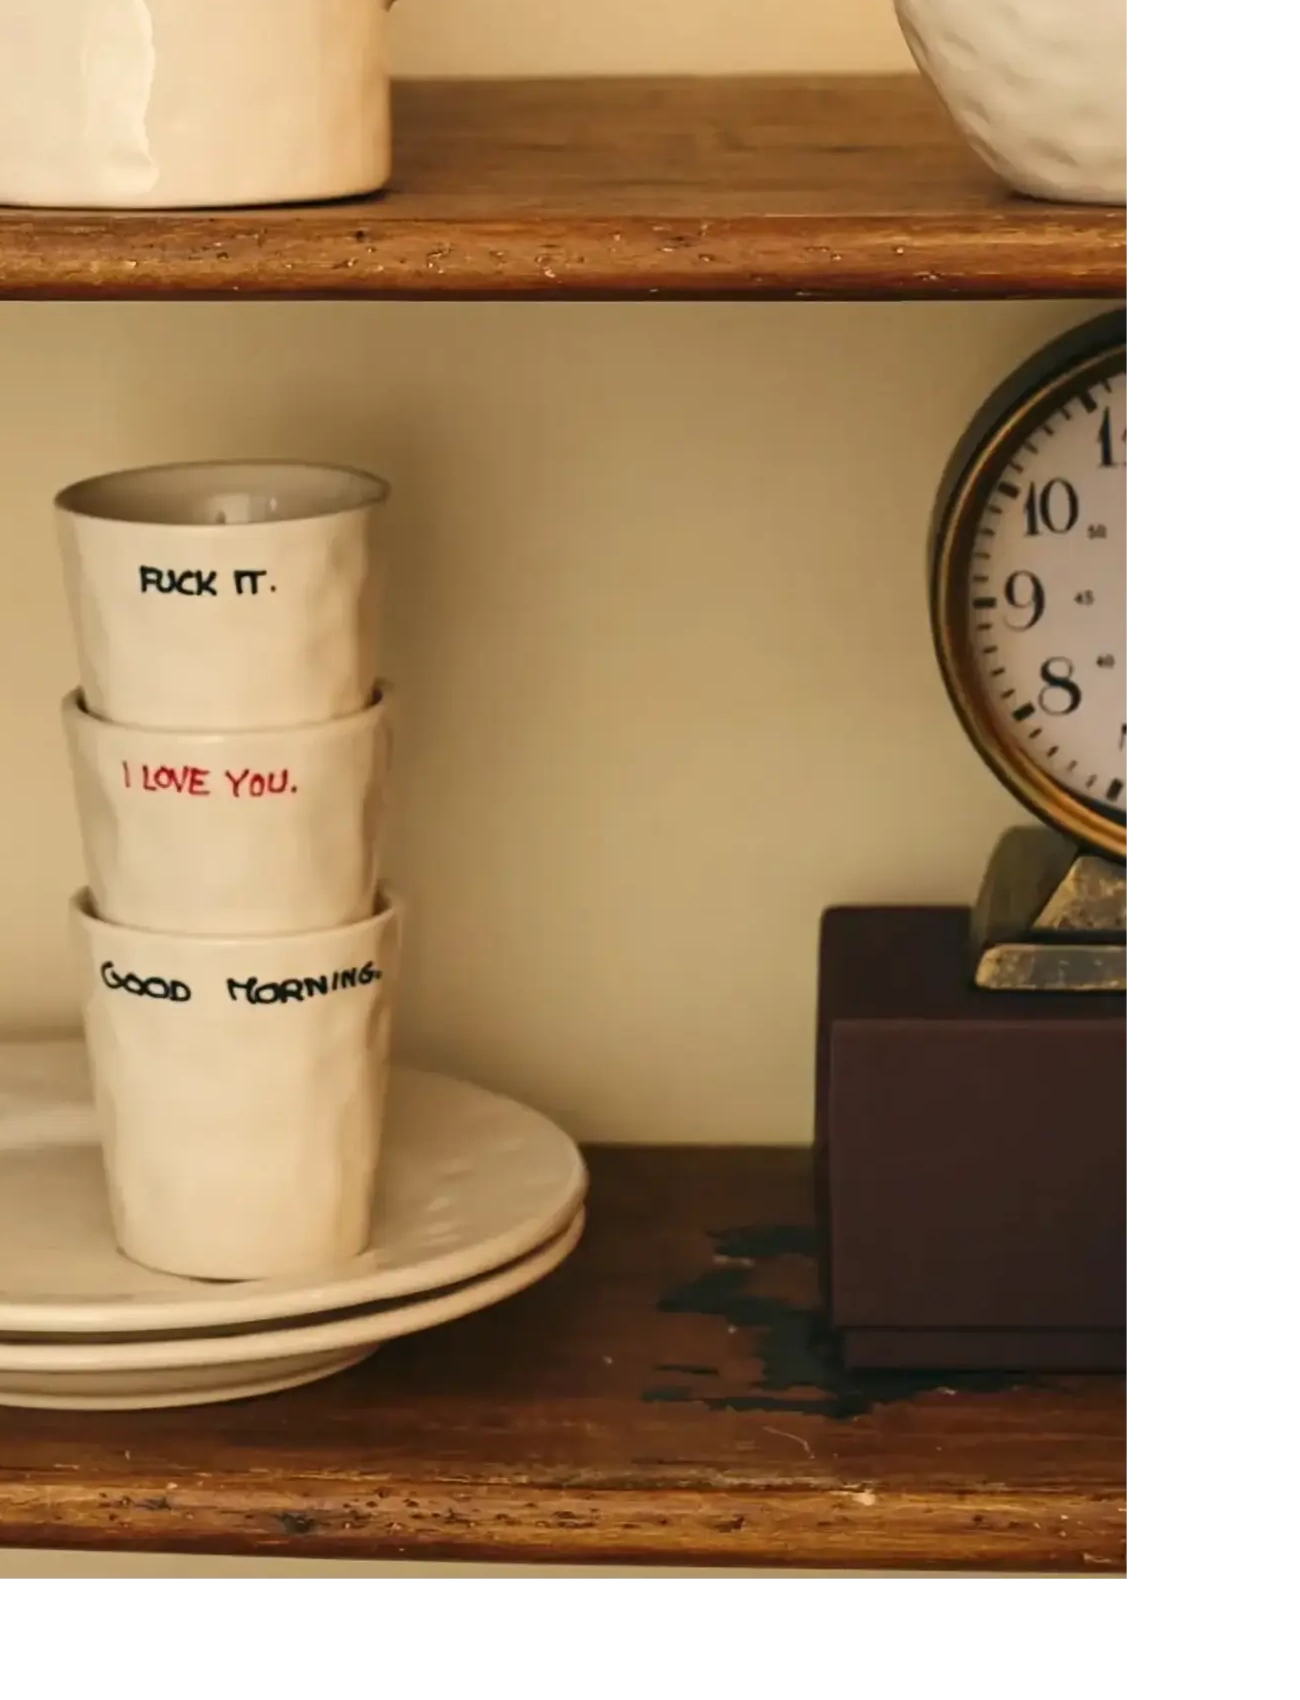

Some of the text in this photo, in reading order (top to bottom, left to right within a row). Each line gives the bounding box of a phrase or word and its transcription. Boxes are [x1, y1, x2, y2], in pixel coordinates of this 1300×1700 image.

[1023, 477, 1080, 537] 10
[139, 565, 277, 596] FUCK IT.
[1002, 569, 1046, 633] 9
[1037, 655, 1082, 717] 8
[121, 760, 298, 798] I LOVE YOU.
[100, 960, 382, 1006] GOOD MORNING.
